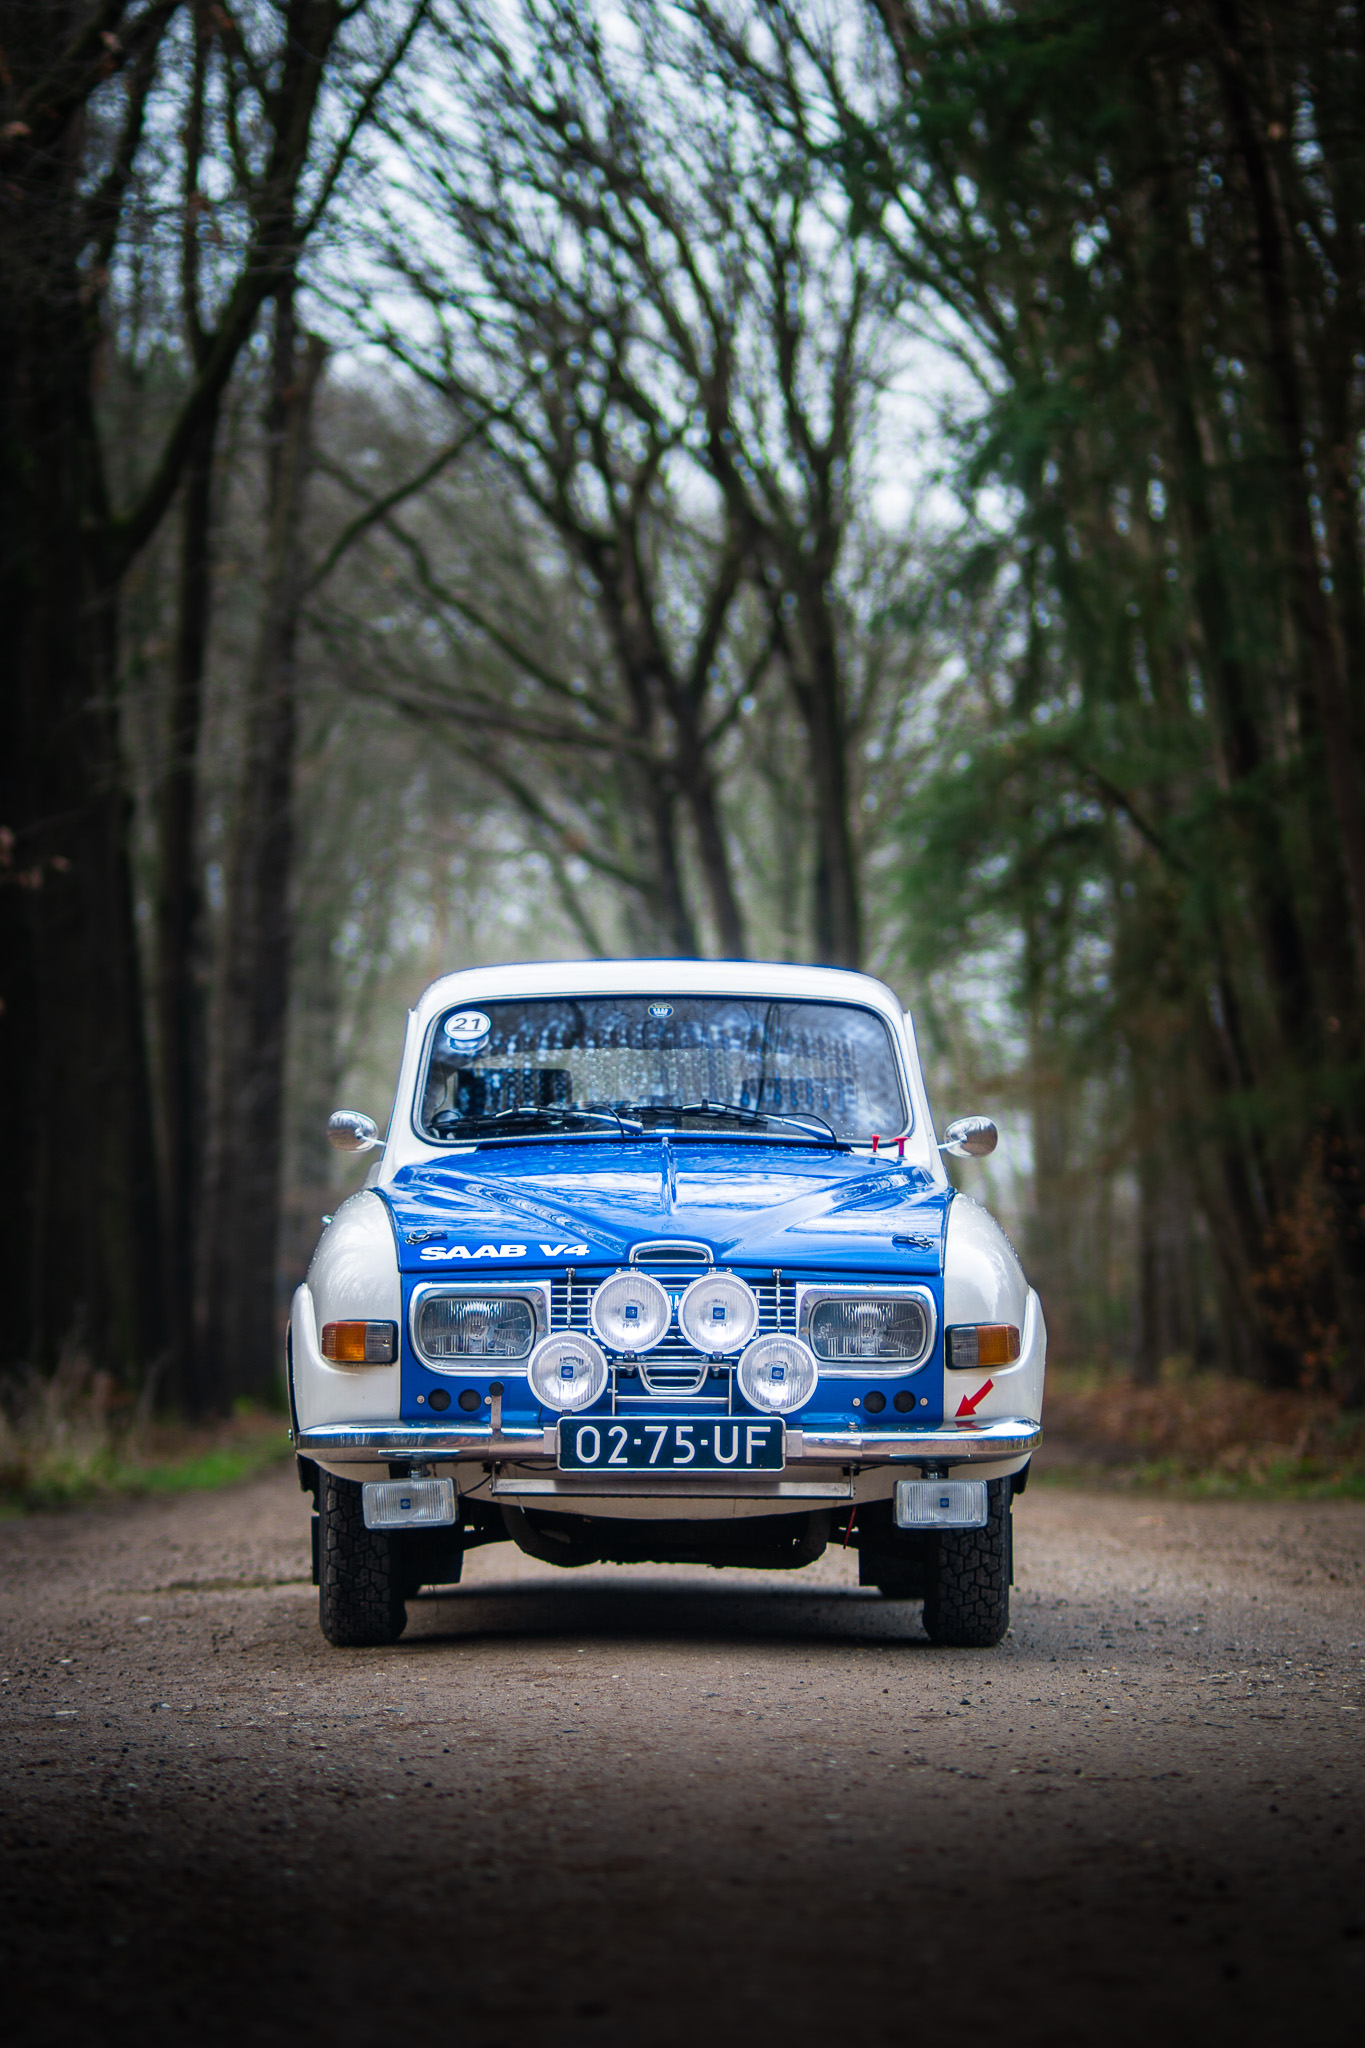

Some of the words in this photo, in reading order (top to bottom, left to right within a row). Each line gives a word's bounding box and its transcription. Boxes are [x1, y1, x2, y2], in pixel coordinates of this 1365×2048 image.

[452, 1017, 481, 1030] 21
[420, 1244, 527, 1261] SAAB
[539, 1244, 590, 1257] V4
[576, 1425, 771, 1464] 02-75-UF
